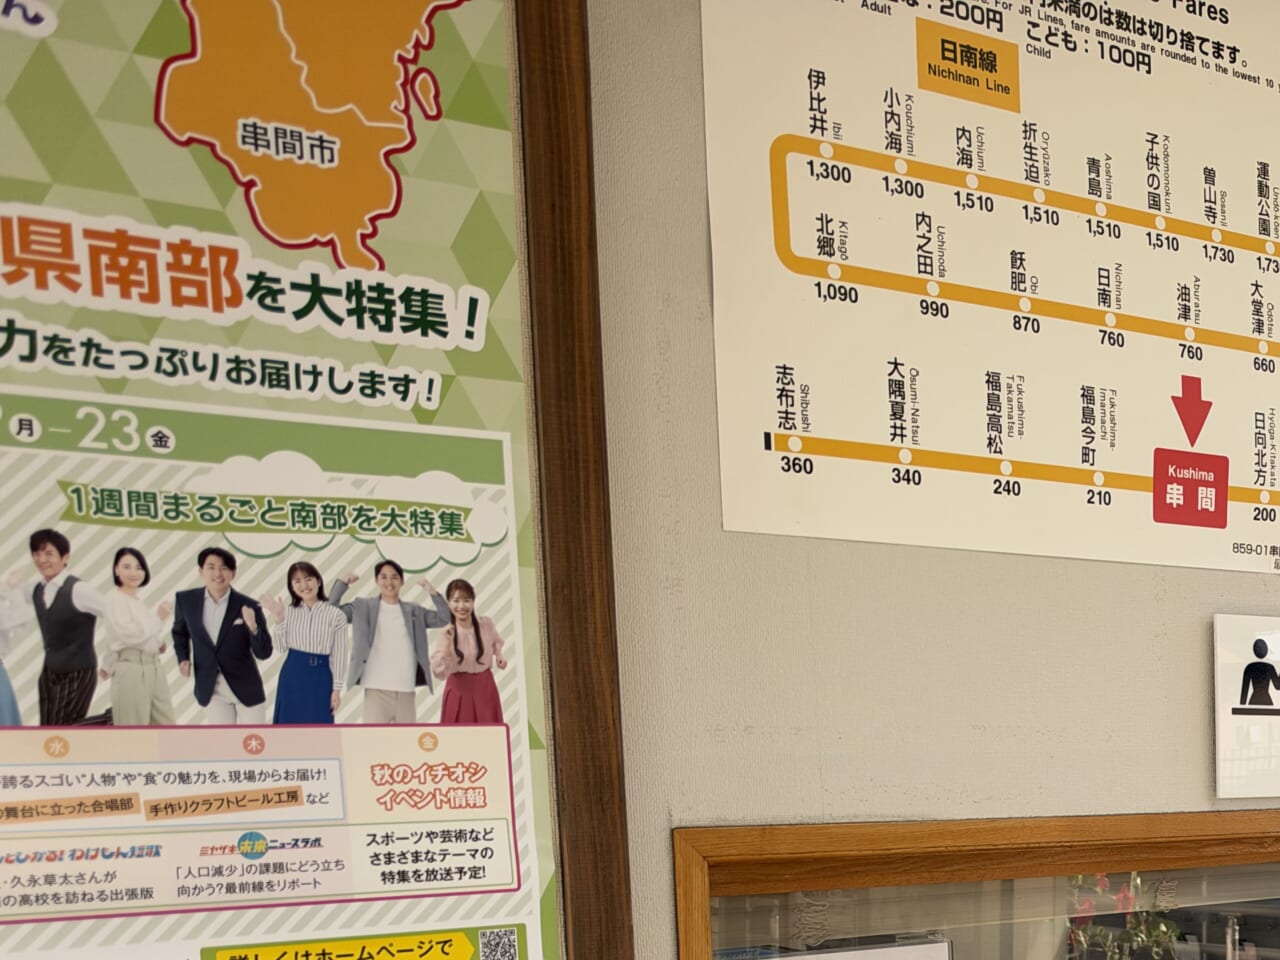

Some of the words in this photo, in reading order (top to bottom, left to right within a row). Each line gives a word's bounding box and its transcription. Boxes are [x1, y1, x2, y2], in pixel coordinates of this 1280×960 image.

[861, 0, 892, 16] Adult
[940, 38, 998, 74] 日南線
[1019, 5, 1032, 17] JR
[1071, 20, 1091, 34] fare
[1095, 28, 1137, 48] amounts
[1141, 40, 1156, 53] are
[1160, 46, 1197, 66] rounded
[1201, 57, 1211, 70] to
[1215, 61, 1229, 76] the
[1232, 68, 1261, 85] lowest
[1265, 78, 1275, 90] 10
[1026, 43, 1052, 59] Child
[927, 63, 980, 88] Nichinan
[985, 78, 1011, 95] Line
[807, 68, 829, 137] 伊比井
[240, 121, 338, 166] 串間市
[1021, 120, 1041, 184] 折生迫
[806, 159, 852, 184] 1,300
[1086, 156, 1103, 198] 青島
[1145, 131, 1162, 213] 子供の国
[1202, 166, 1218, 225] 曽山寺
[1256, 160, 1271, 238] 運動公園
[815, 213, 836, 259] 北郷
[915, 211, 935, 277] 内之田
[1085, 217, 1122, 240] 1,510
[1010, 249, 1027, 293] 飫肥
[814, 281, 859, 304] 1,090
[1176, 282, 1191, 322] 油津
[1250, 280, 1265, 336] 大堂津
[919, 299, 950, 319] 990
[1178, 343, 1203, 361] 760
[1253, 357, 1276, 374] 660
[775, 363, 798, 432] 志布志
[887, 357, 908, 444] 大隅夏井
[984, 370, 1004, 456] 福島高松
[150, 430, 170, 449] 金
[1080, 385, 1096, 467] 福島今町
[1254, 411, 1267, 487] 日向北方
[780, 456, 814, 475] 360
[1168, 464, 1215, 482] Kushima
[992, 478, 1022, 497] 240
[1086, 489, 1112, 506] 210
[1165, 483, 1217, 512] 串間
[69, 485, 467, 539] 1週間まるごと南部を大特集
[1253, 507, 1277, 522] 200
[370, 762, 488, 786] 秋のイチオシ
[149, 788, 299, 818] 手作りクラフトビール工房
[305, 791, 330, 805] など
[376, 787, 488, 811] イベント情報
[366, 827, 495, 847] スポーツや芸術など
[369, 847, 494, 866] さまざまなテーマの
